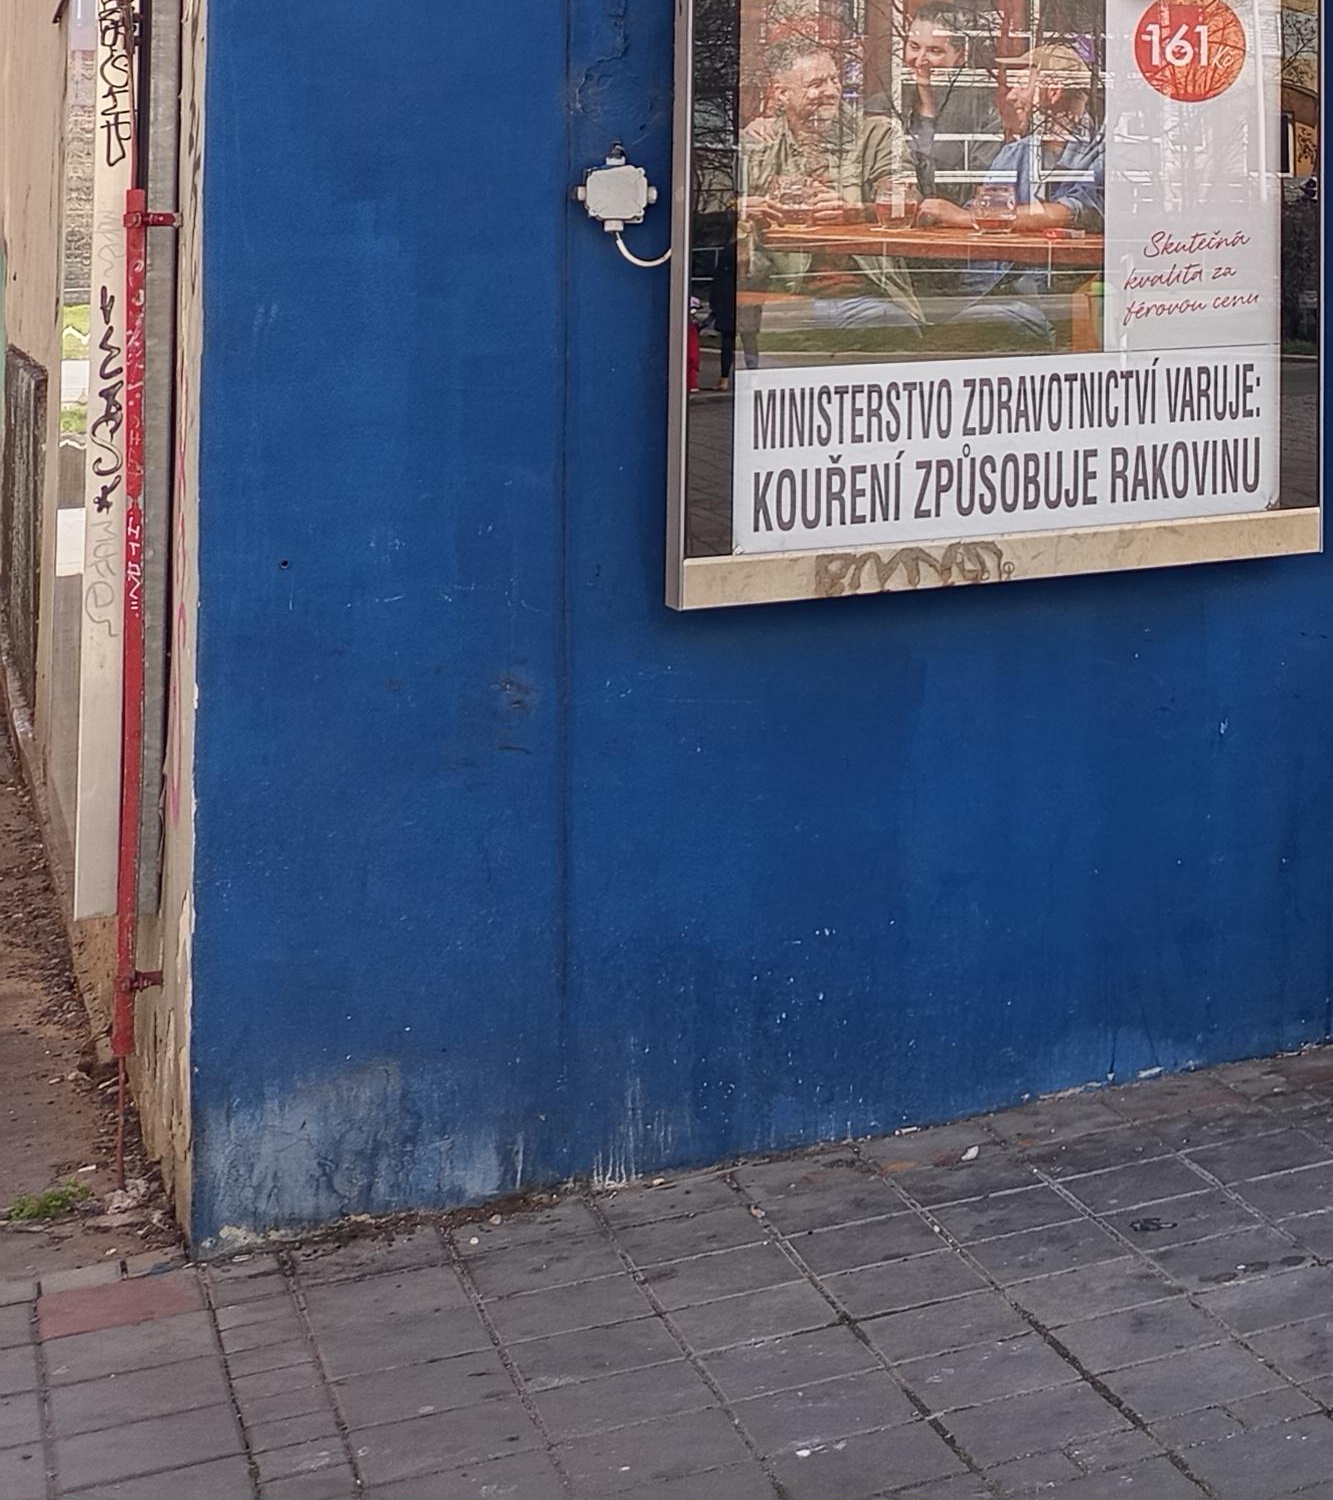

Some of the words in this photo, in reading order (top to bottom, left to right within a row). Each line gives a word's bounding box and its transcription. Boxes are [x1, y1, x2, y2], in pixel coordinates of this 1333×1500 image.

[1144, 23, 1209, 67] 161
[1143, 230, 1251, 258] Skutečná
[1123, 263, 1203, 291] kvalita
[1211, 266, 1237, 280] za
[1122, 299, 1208, 326] férovou
[1212, 293, 1260, 309] cenu
[752, 377, 952, 451] MINISTERSTVO
[961, 358, 1159, 437] ZDRAVOTNICTVÍ
[1165, 362, 1262, 423] VARUJE:
[752, 451, 903, 533] KOUŘENÍ
[914, 443, 1098, 520] ZPŮSOBUJE
[1110, 436, 1261, 506] RAKOVINU
